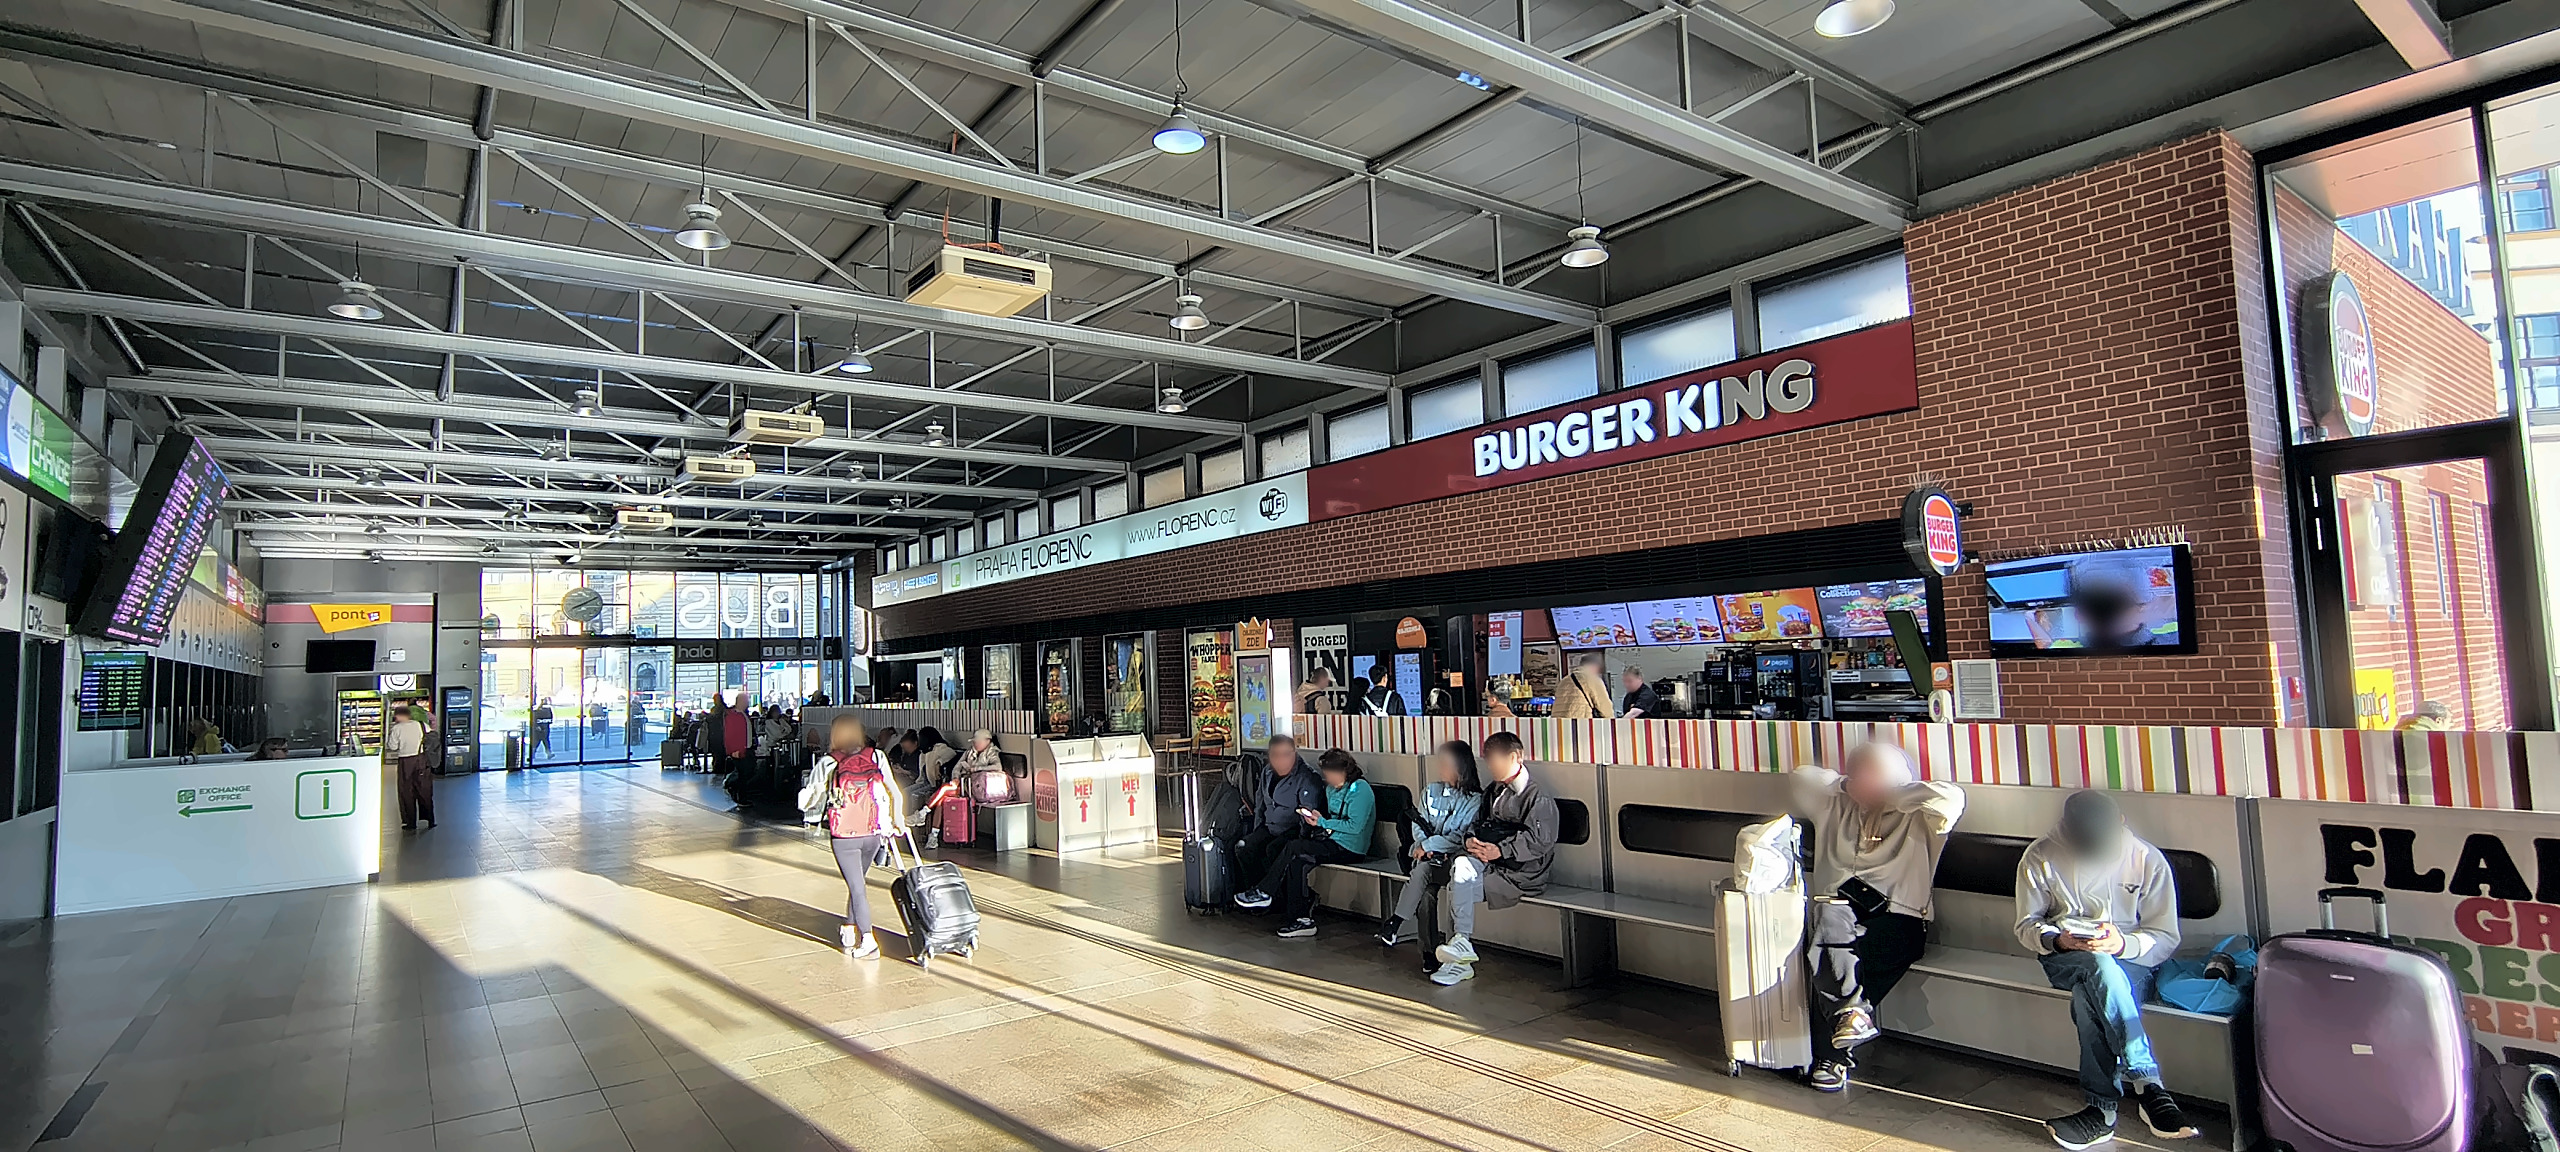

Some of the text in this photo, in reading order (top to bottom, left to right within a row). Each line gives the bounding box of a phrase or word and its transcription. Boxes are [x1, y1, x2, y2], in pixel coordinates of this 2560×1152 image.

[2338, 327, 2366, 361] BURGER
[2339, 354, 2370, 398] KING
[1473, 359, 1816, 478] BURGER KING
[32, 438, 71, 488] CHANGE
[1927, 517, 1954, 533] BURGER
[1928, 531, 1956, 552] KING
[975, 533, 1092, 581] PRAHA FLORENC
[1820, 588, 1861, 598] Collection
[331, 609, 366, 622] pont
[1246, 637, 1260, 647] ZDE
[1304, 635, 1347, 647] FORGED
[678, 645, 714, 658] hala
[1190, 643, 1232, 657] WHOPPER
[1201, 655, 1219, 664] FAMILY
[1771, 659, 1789, 667] pepsi
[1304, 649, 1348, 687] IN
[199, 785, 251, 795] EXCHANGE
[1036, 784, 1057, 798] BURGER
[1074, 784, 1093, 797] ME!
[1122, 779, 1140, 792] ME!
[208, 793, 242, 802] OFFICE
[1036, 796, 1057, 812] KING
